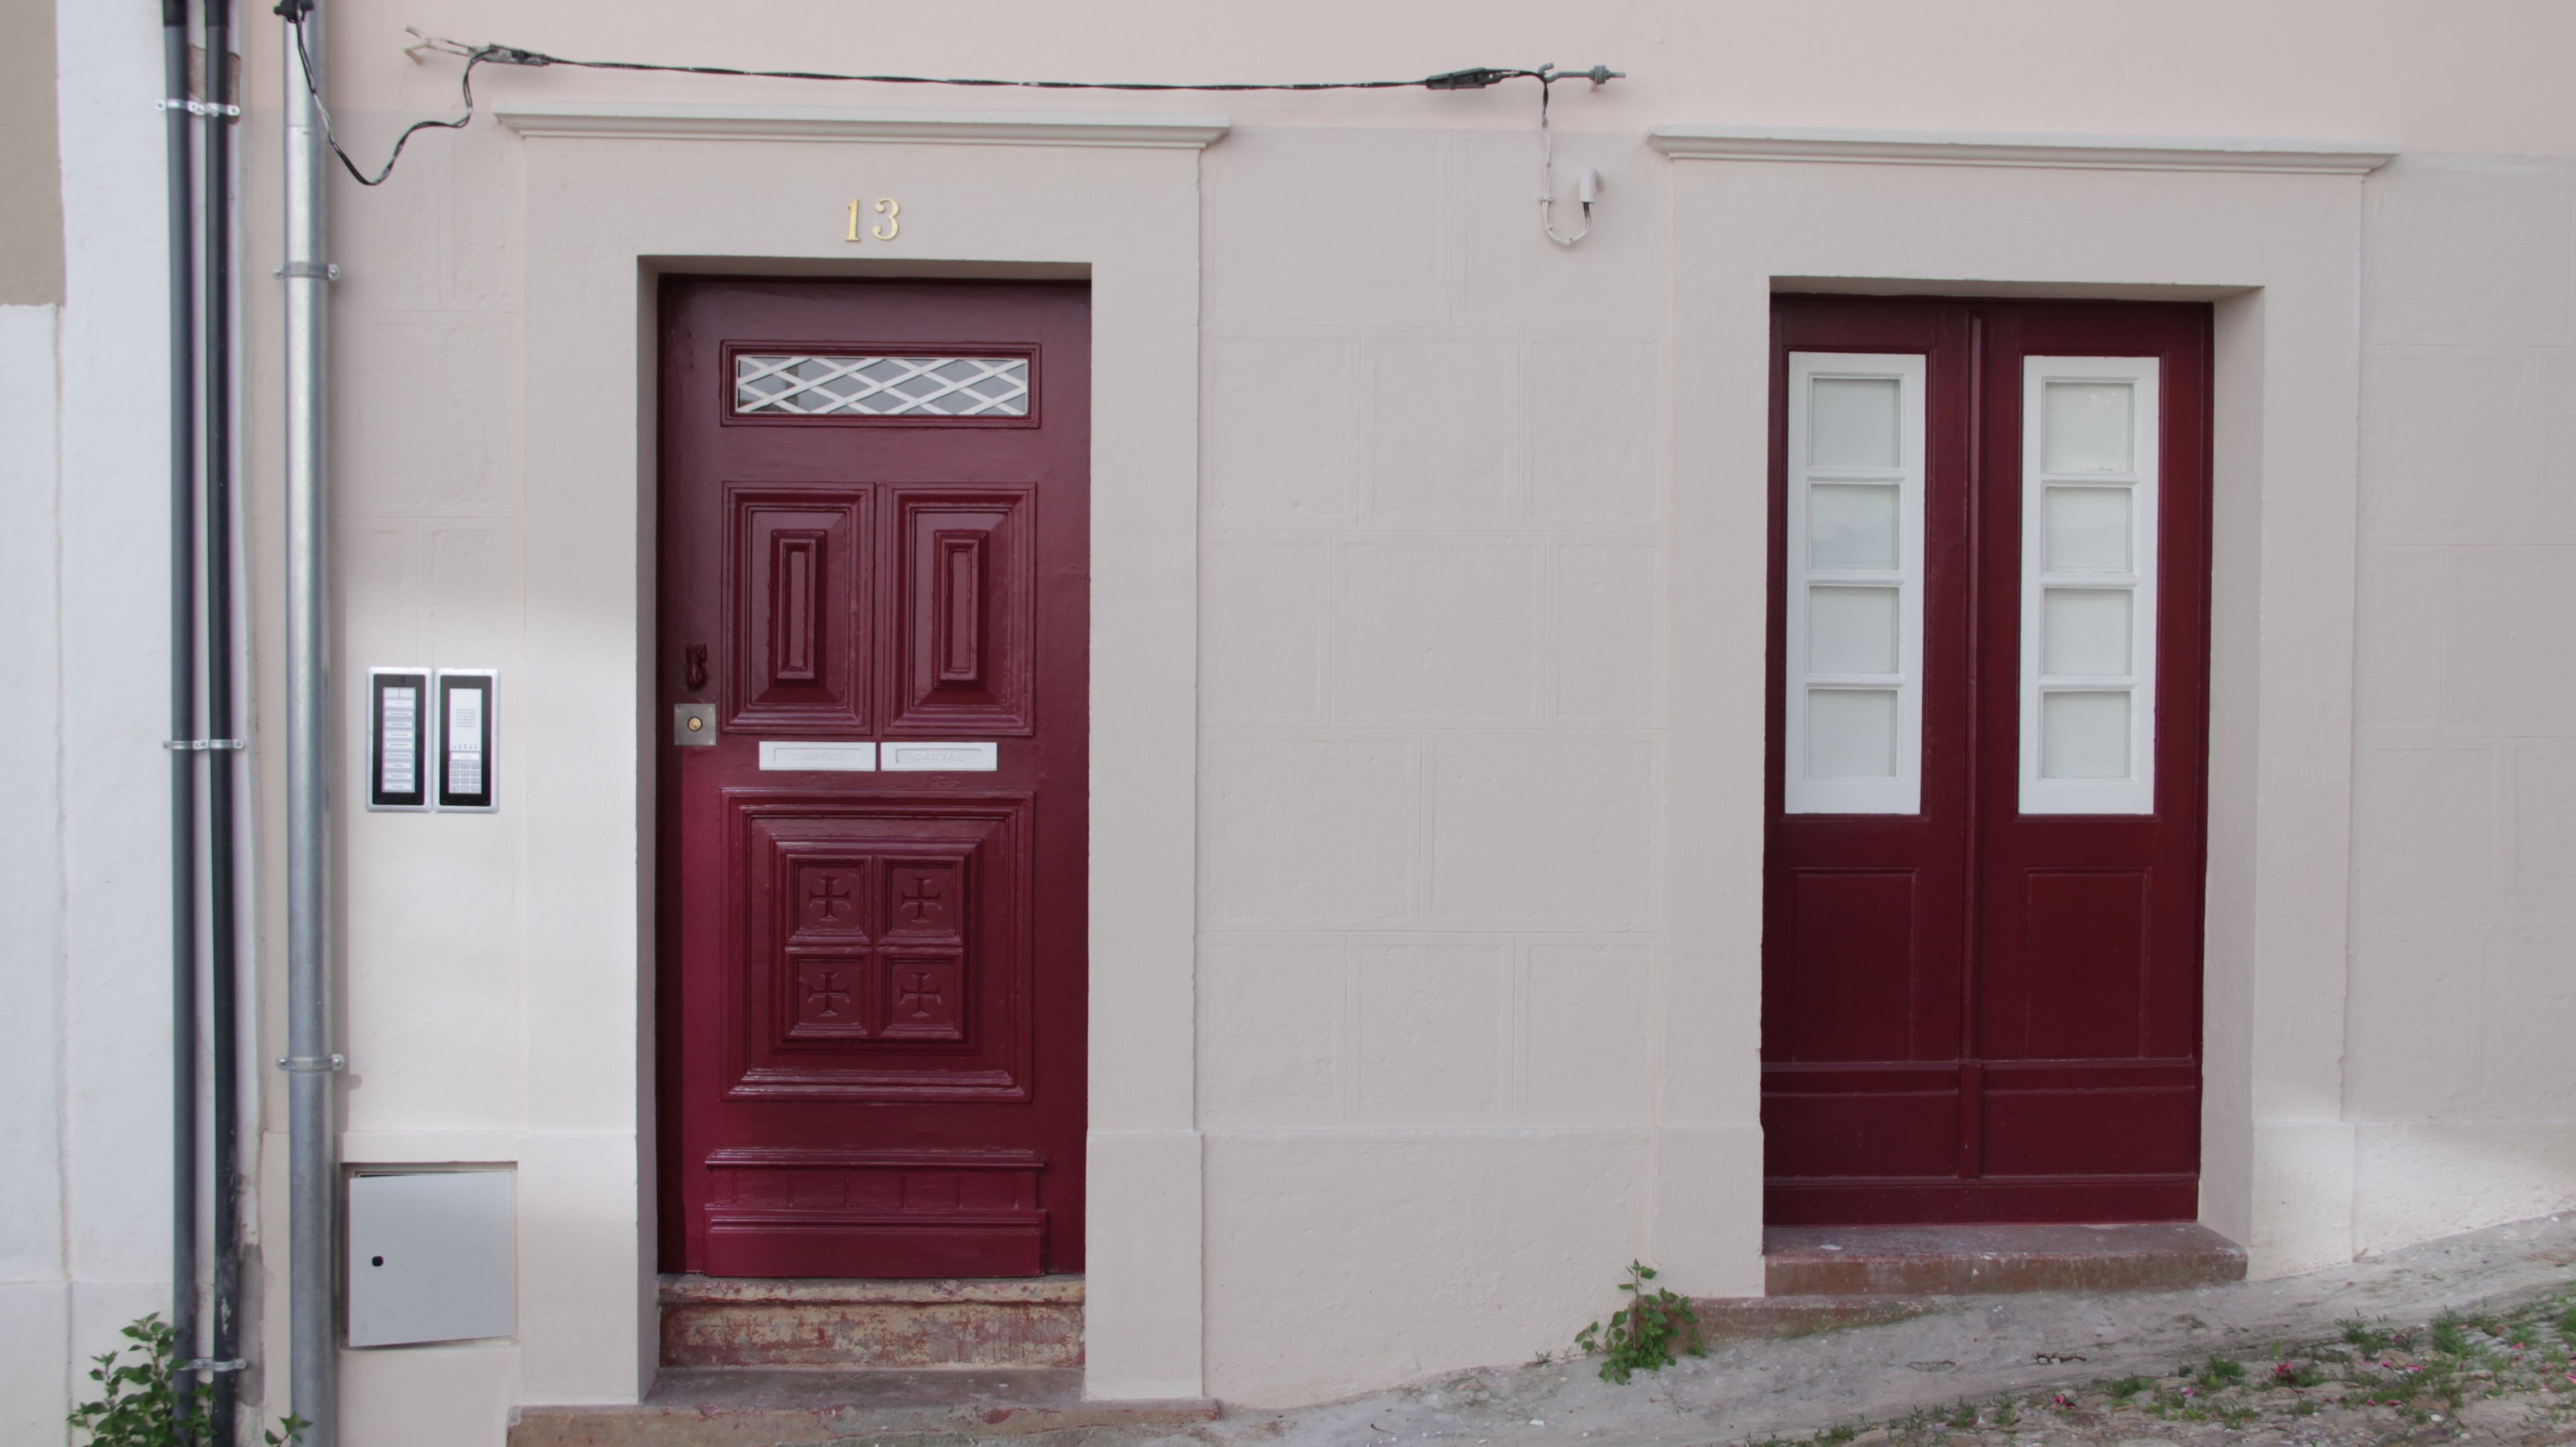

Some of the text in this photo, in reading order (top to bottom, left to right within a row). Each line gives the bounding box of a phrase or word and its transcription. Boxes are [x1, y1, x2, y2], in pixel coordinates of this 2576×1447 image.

[845, 197, 900, 242] 13
[791, 752, 843, 761] CARTAS
[913, 752, 965, 761] CARTAS
